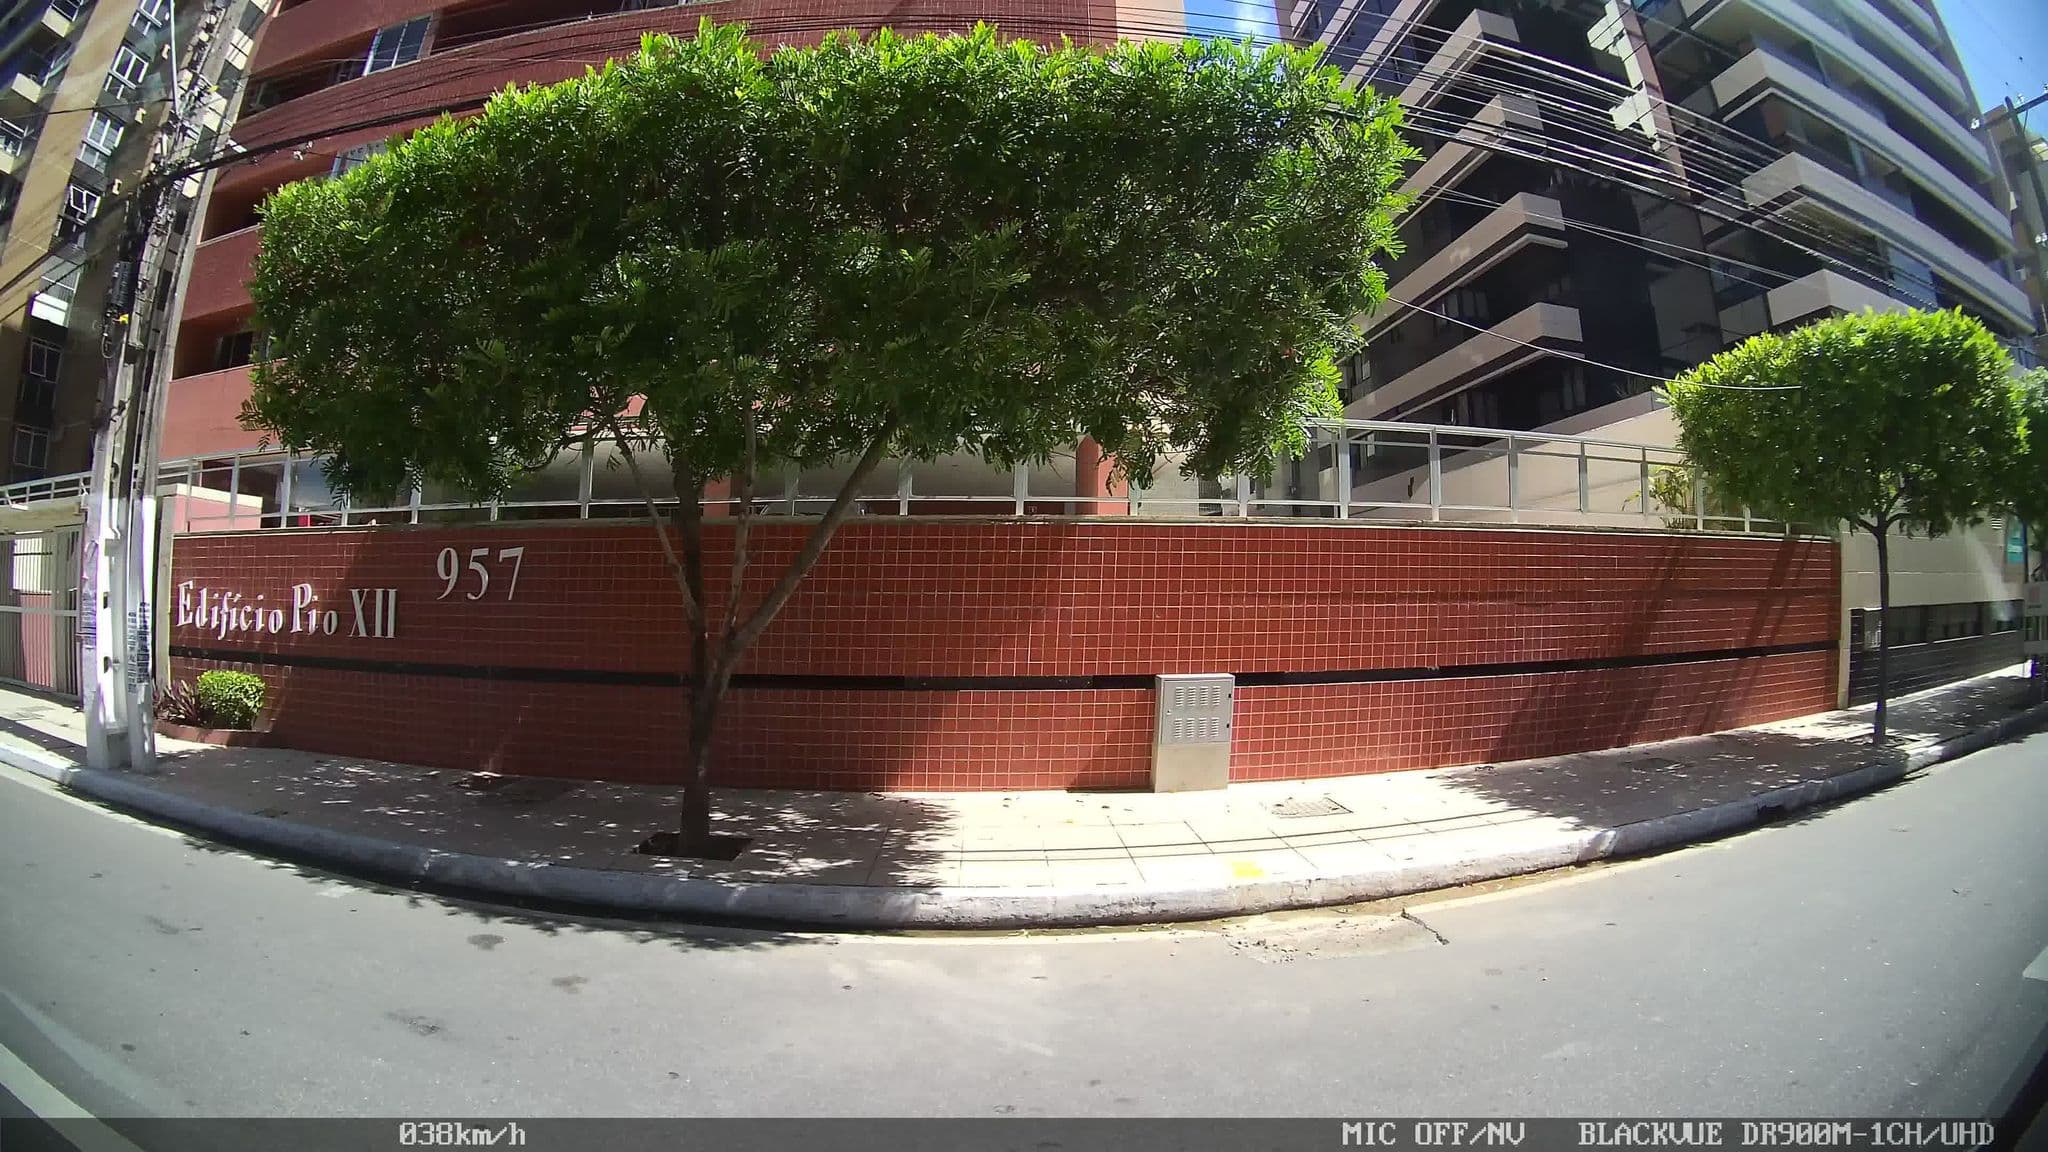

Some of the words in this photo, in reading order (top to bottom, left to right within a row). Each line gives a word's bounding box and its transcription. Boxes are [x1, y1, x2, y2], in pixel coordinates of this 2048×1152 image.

[436, 546, 524, 601] 957
[176, 580, 284, 641] Edifício
[290, 583, 339, 636] Pio
[347, 588, 398, 639] XII
